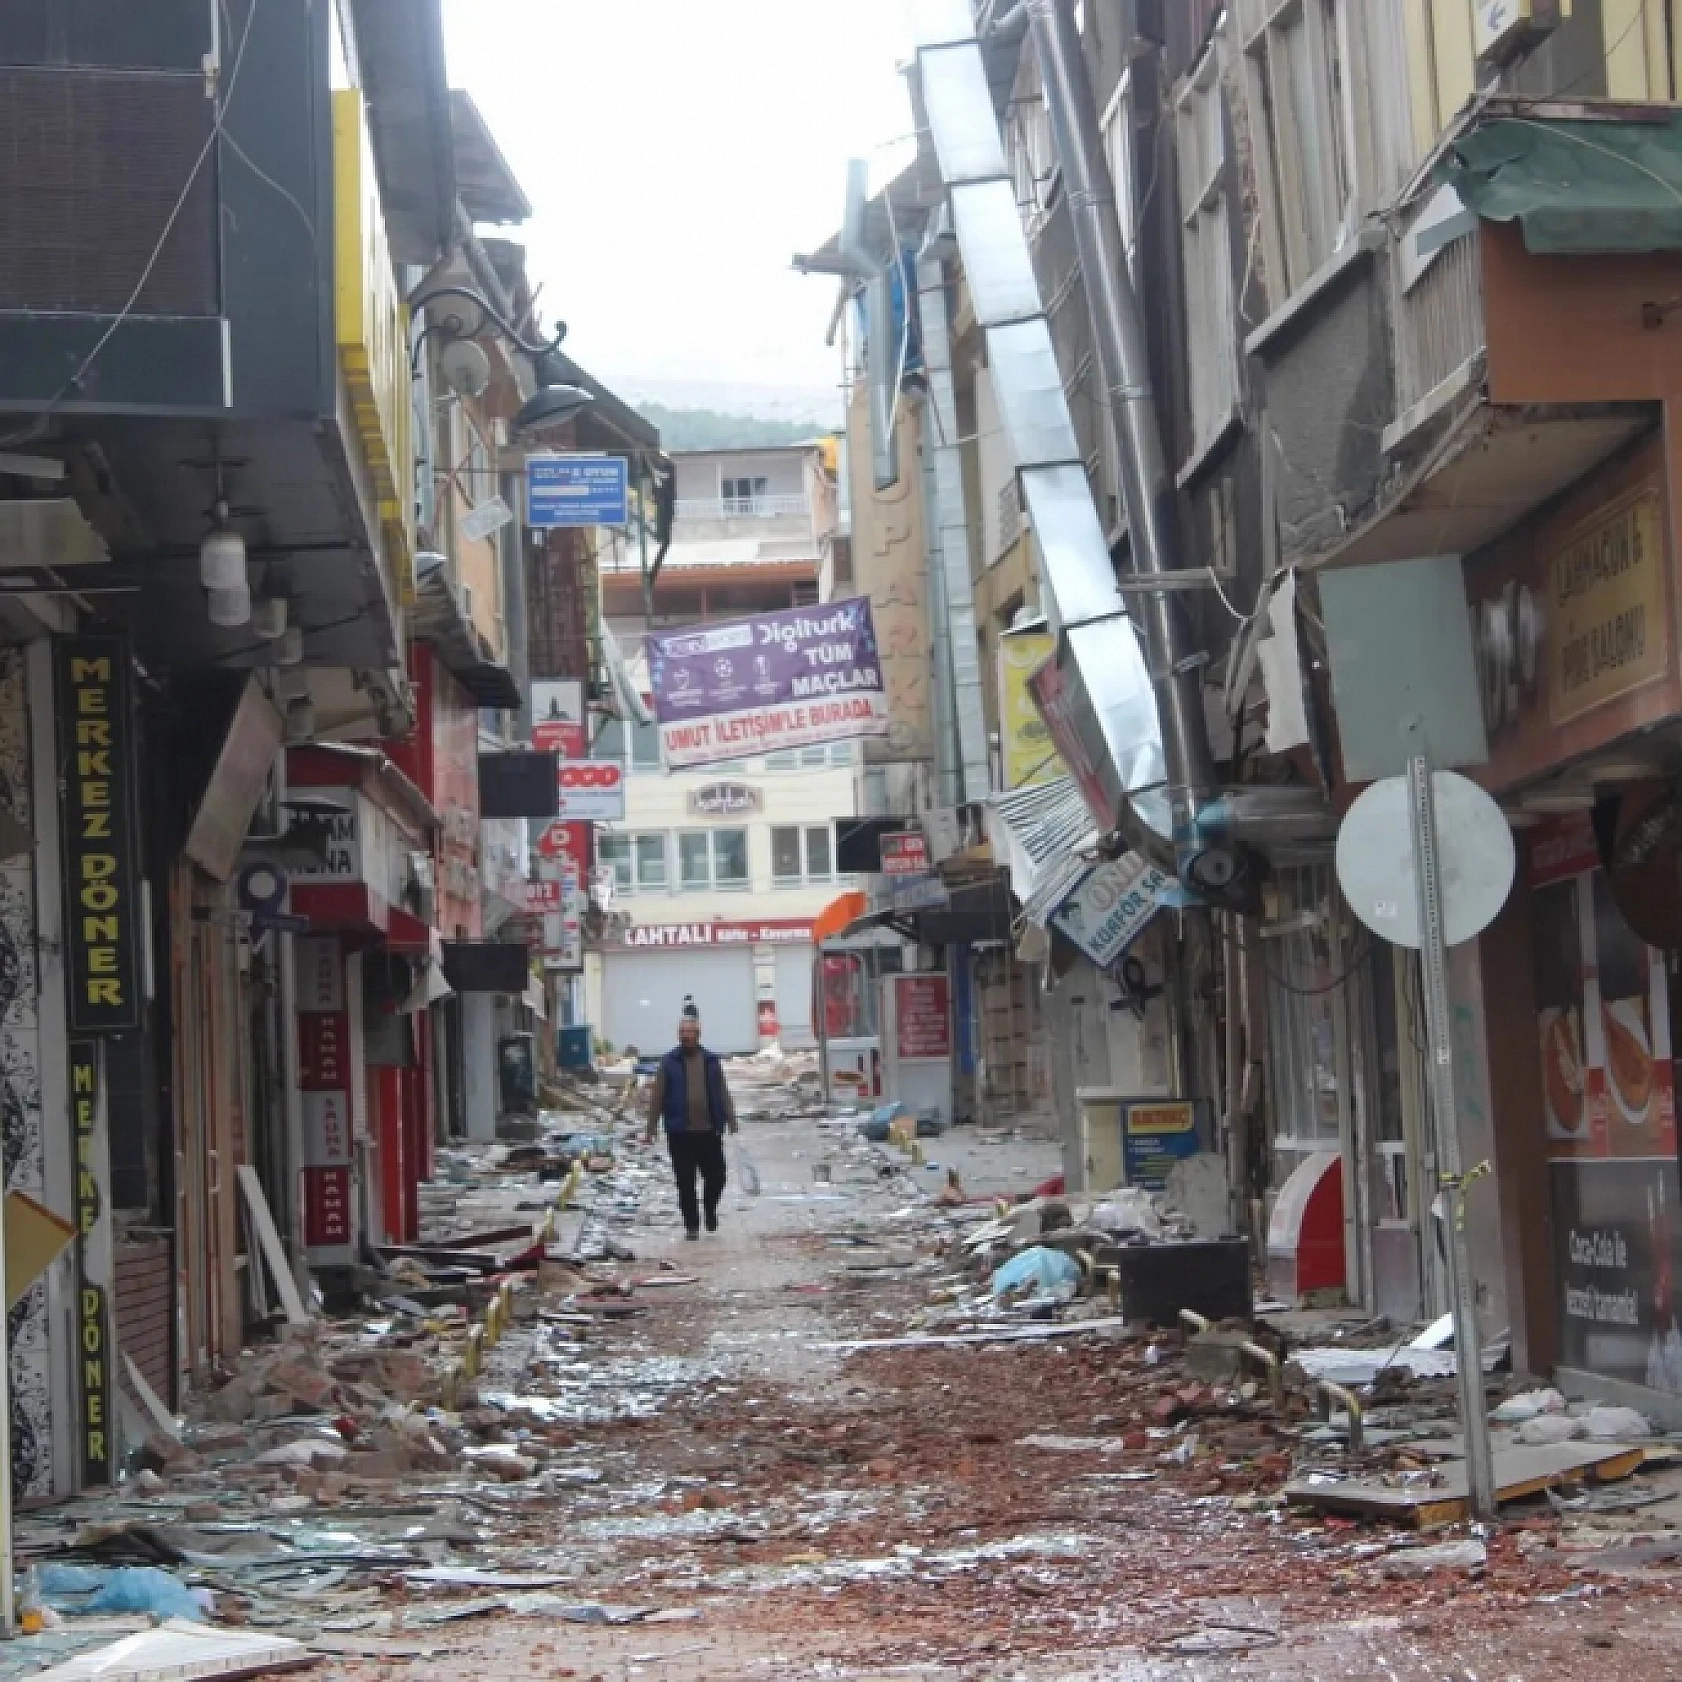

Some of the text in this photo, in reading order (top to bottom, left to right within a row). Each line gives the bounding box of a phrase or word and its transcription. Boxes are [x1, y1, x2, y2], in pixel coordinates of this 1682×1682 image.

[792, 668, 877, 697] MAÇLAR
[804, 641, 852, 667] TÜM
[664, 725, 711, 751] UMUT
[809, 698, 873, 724] BURADA
[70, 656, 125, 1005] MERKEZ DÖNER
[323, 1171, 343, 1235] HAMAM
[82, 1289, 105, 1461] DÖNER
